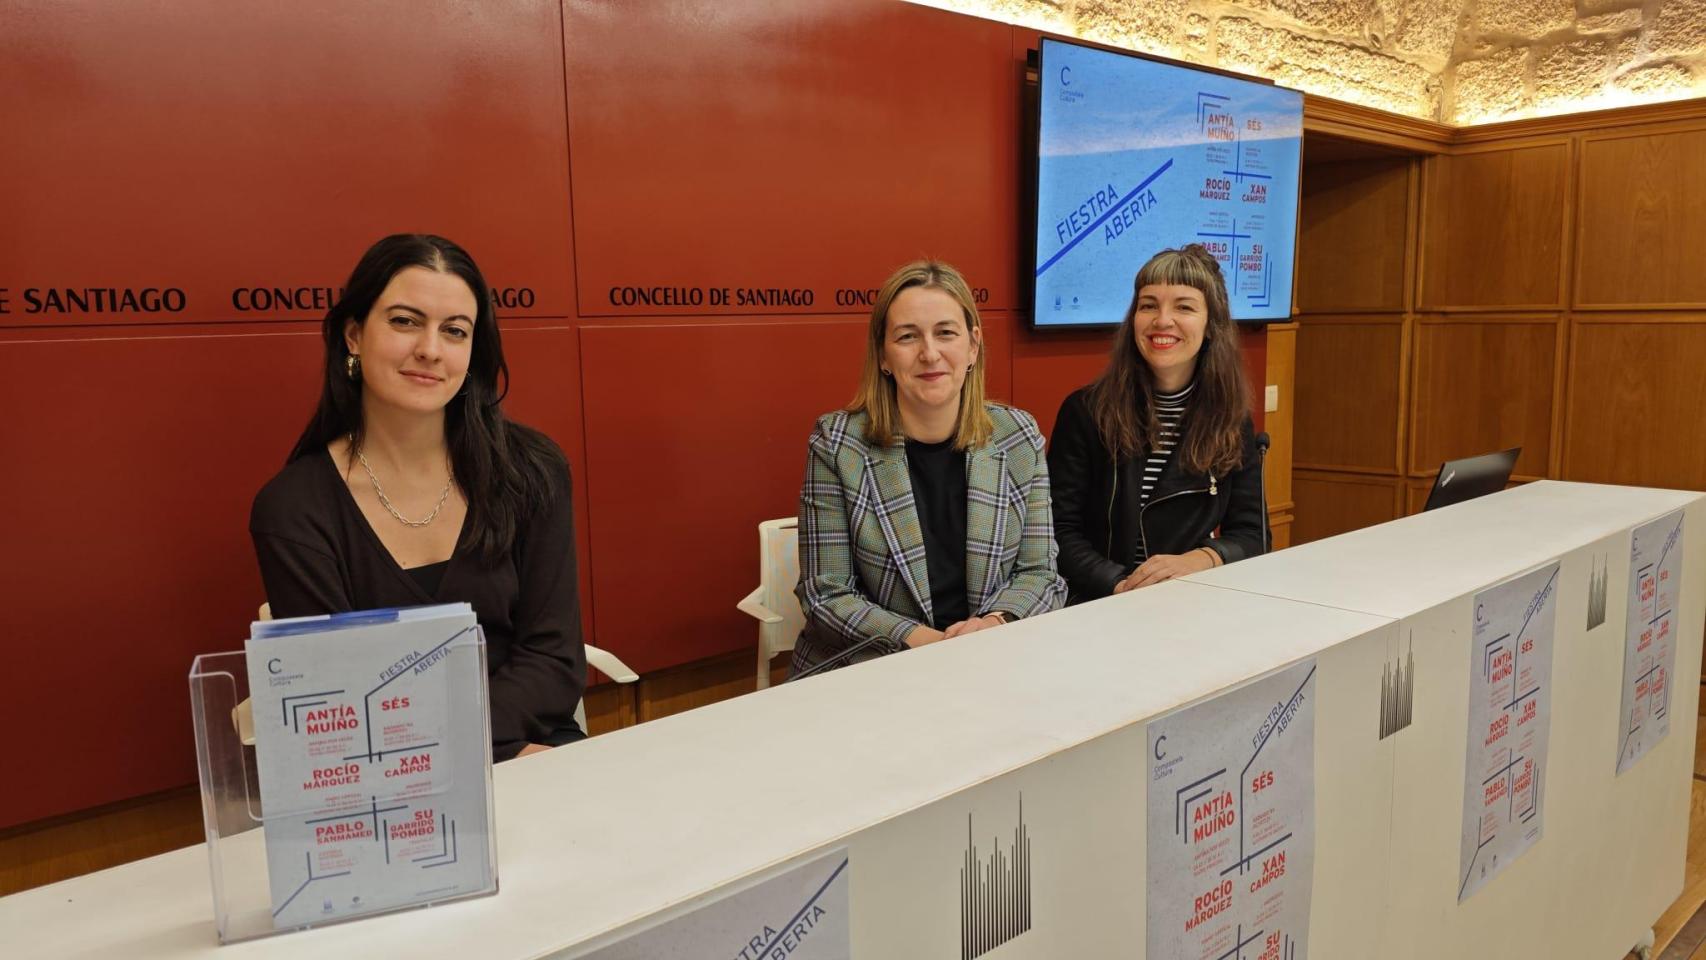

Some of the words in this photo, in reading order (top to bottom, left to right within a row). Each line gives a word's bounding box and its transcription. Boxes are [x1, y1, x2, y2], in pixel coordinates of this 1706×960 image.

[1206, 177, 1231, 191] ROCÍO
[1251, 184, 1266, 195] XAN
[1241, 193, 1266, 204] CAMPOS
[1056, 183, 1119, 244] FIESTRA
[1104, 189, 1157, 246] ABERTA
[1253, 244, 1263, 254] SU
[1239, 262, 1262, 272] POMBO
[23, 288, 187, 314] SANTIAGO
[609, 287, 703, 306] CONCELLO
[709, 287, 731, 306] DE
[736, 288, 814, 306] SANTIAGO
[268, 658, 282, 674] C
[379, 650, 422, 681] FIESTRA
[414, 647, 452, 676] ABERTA
[306, 703, 356, 722] ANTÍA
[382, 696, 410, 711] SÉS
[1277, 692, 1305, 738] ABERTA
[306, 717, 359, 735] MUÍÑO
[1252, 701, 1284, 749] FIESTRA
[1154, 735, 1167, 761] C
[399, 754, 431, 768] XAN
[313, 763, 360, 779] ROCÍO
[384, 764, 431, 778] CAMPOS
[1252, 770, 1274, 793] SÉS
[414, 809, 433, 821] SU
[1194, 790, 1233, 824] ANTÍA
[315, 820, 364, 837] PABLO
[390, 819, 434, 832] GARRIDO
[391, 826, 435, 840] POMBO
[1194, 810, 1235, 845] MUÍÑO
[317, 829, 373, 845] SANMAMED
[1262, 850, 1286, 875] XAN
[1250, 864, 1285, 893] CAMPOS
[1195, 879, 1233, 913] ROCÍO
[1266, 929, 1281, 950] SU
